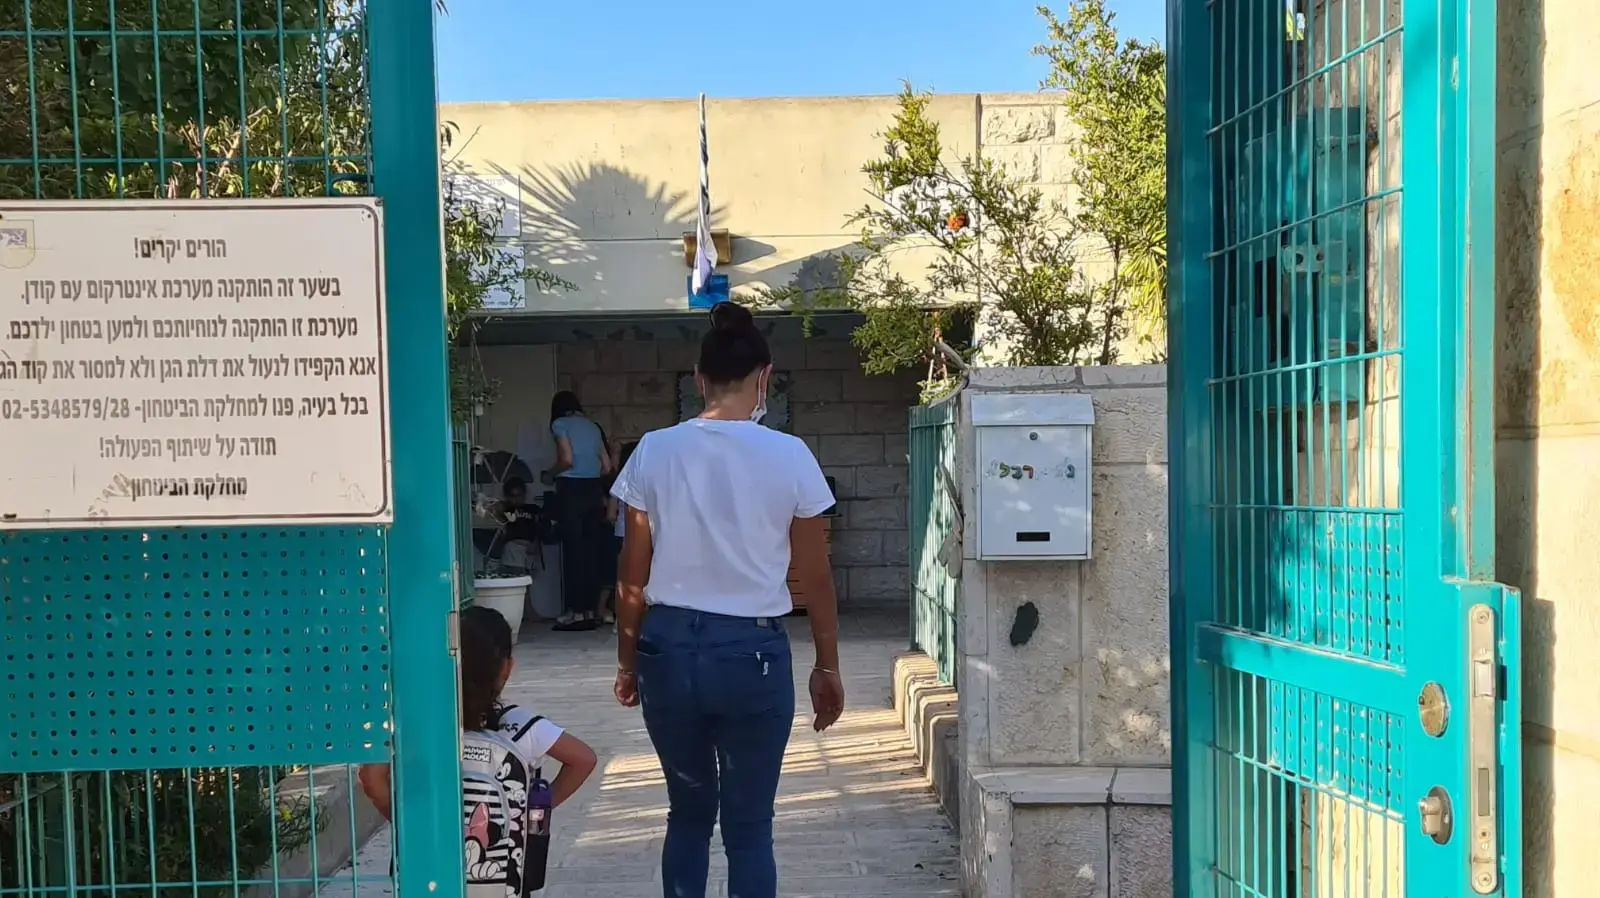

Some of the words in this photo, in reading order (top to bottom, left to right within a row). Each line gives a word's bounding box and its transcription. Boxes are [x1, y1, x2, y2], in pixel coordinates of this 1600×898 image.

[134, 237, 181, 263] יקרים!
[186, 239, 226, 258] הורים
[21, 280, 55, 304] קודן.
[60, 280, 82, 302] עם
[87, 280, 158, 304] אינטרקום
[162, 279, 213, 301] מערכת
[217, 279, 273, 303] הותקנה
[277, 278, 294, 297] זה
[298, 277, 341, 299] בשער
[6, 316, 55, 340] ילדכם.
[60, 319, 102, 344] בטחון
[107, 315, 148, 344] ולמען
[152, 314, 227, 338] לנוחיותכם
[232, 318, 287, 343] הותקנה
[292, 318, 303, 336] זו
[308, 317, 357, 339] מערכת
[0, 360, 17, 379] הג
[21, 360, 47, 384] קוד
[52, 360, 75, 379] את
[79, 355, 125, 378] למסור
[130, 355, 155, 378] ולא
[160, 359, 182, 383] הגן
[187, 355, 217, 378] דלת
[223, 359, 245, 377] את
[248, 353, 289, 379] לנעול
[294, 357, 344, 381] הקפידו
[349, 357, 376, 376] אנא
[2, 397, 130, 420] 02-5348579/28
[135, 399, 199, 423] הביטחון-
[204, 393, 267, 422] למחלקת
[273, 398, 293, 416] פנו
[298, 397, 336, 418] בעיה,
[340, 392, 368, 415] בכל
[100, 435, 161, 460] הפעולה!
[167, 437, 211, 462] שיתוף
[216, 434, 235, 459] על
[240, 436, 276, 456] תודה
[130, 478, 189, 502] הביטחון
[193, 473, 247, 501] מחלקת
